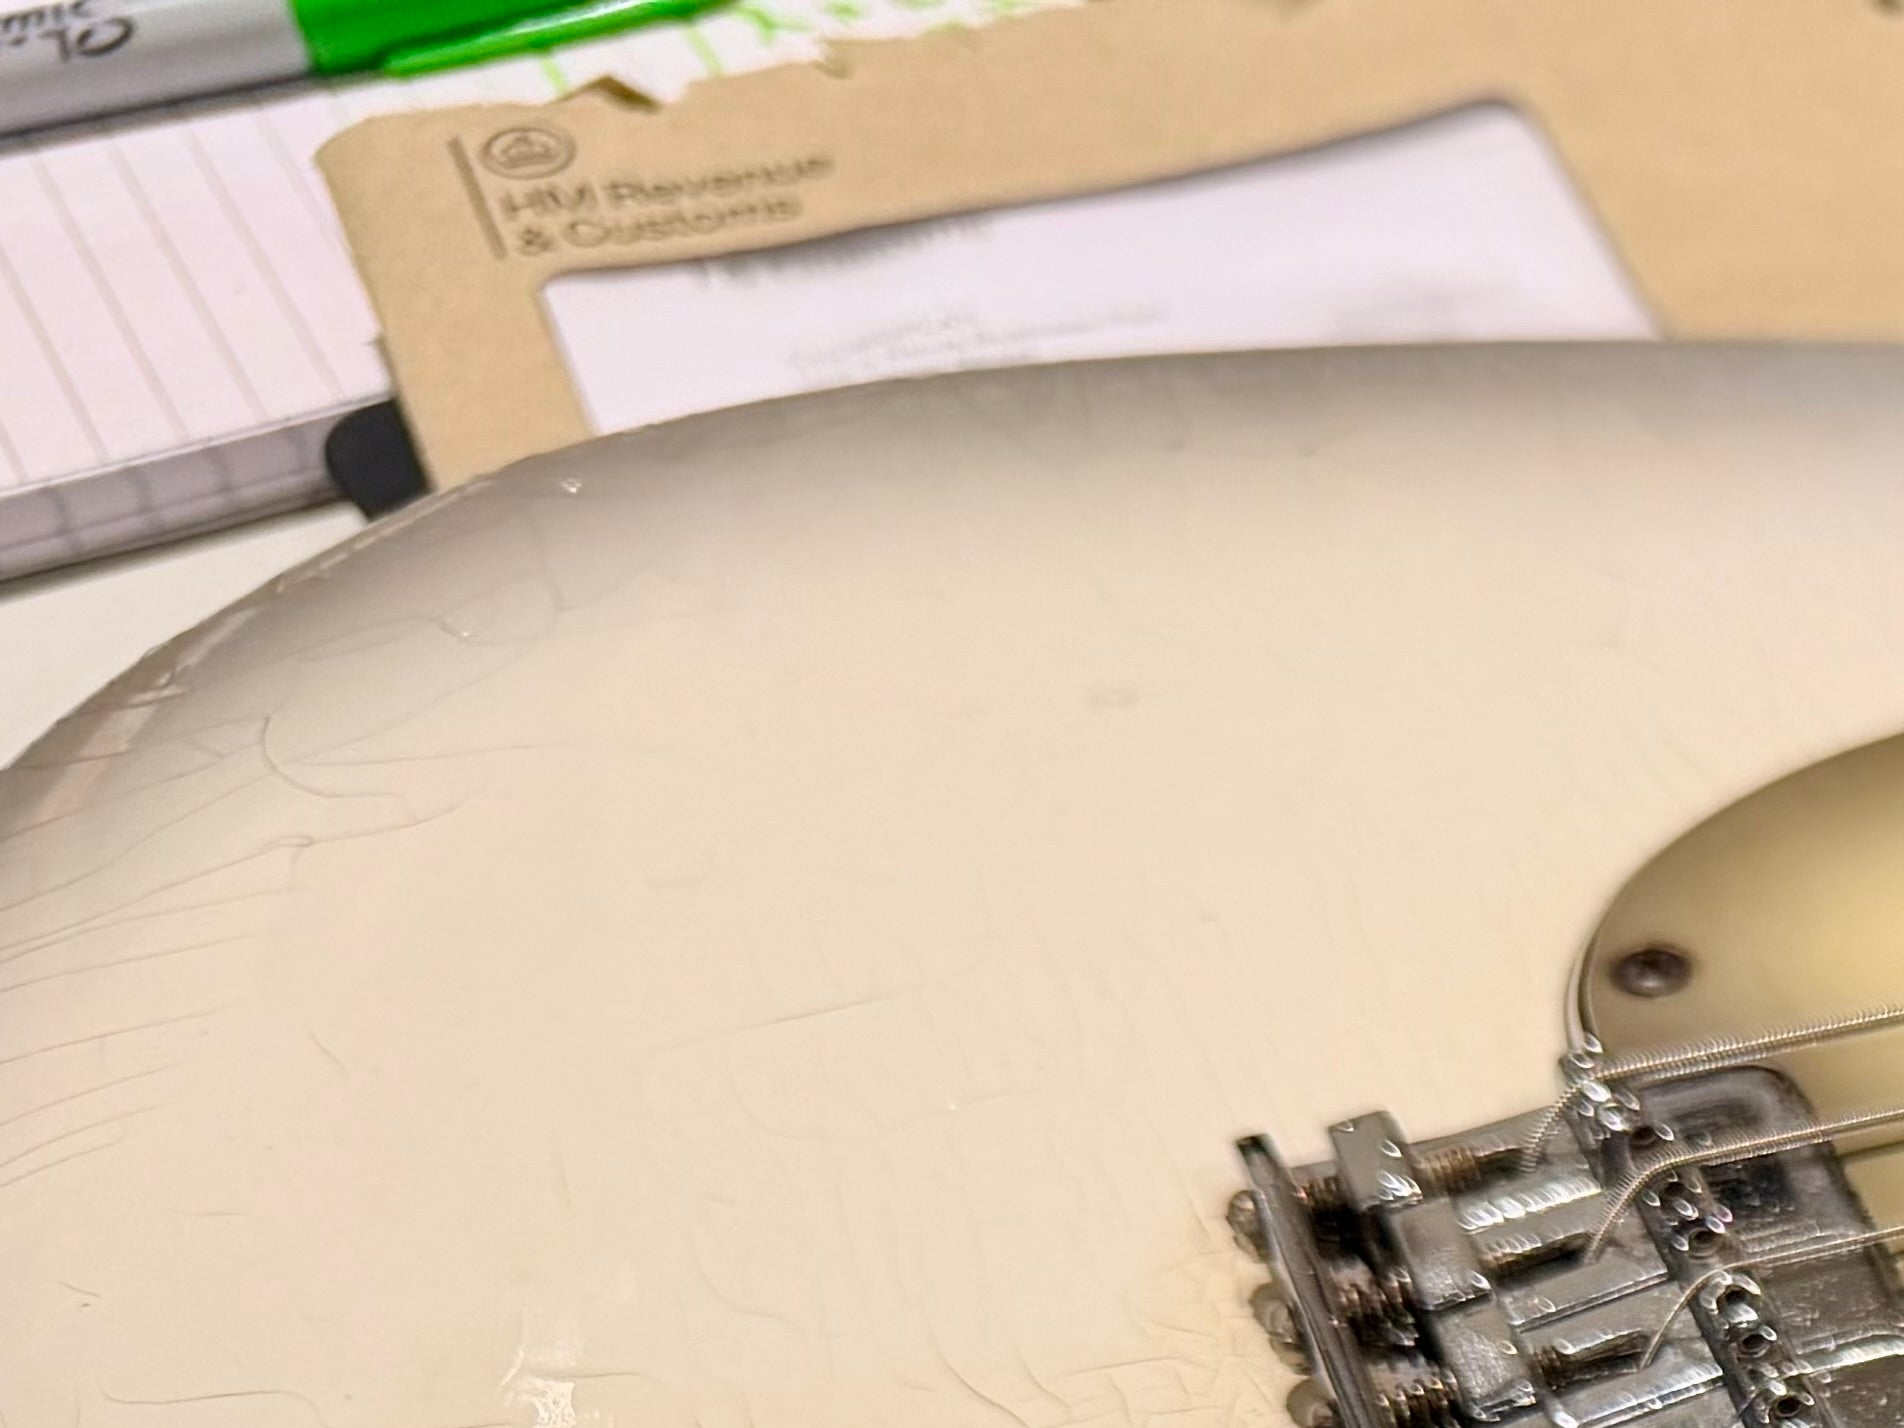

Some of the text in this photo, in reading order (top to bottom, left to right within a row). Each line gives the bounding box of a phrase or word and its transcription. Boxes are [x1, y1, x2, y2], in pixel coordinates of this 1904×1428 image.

[502, 151, 835, 220] HM Revenue
[562, 191, 803, 248] Customs
